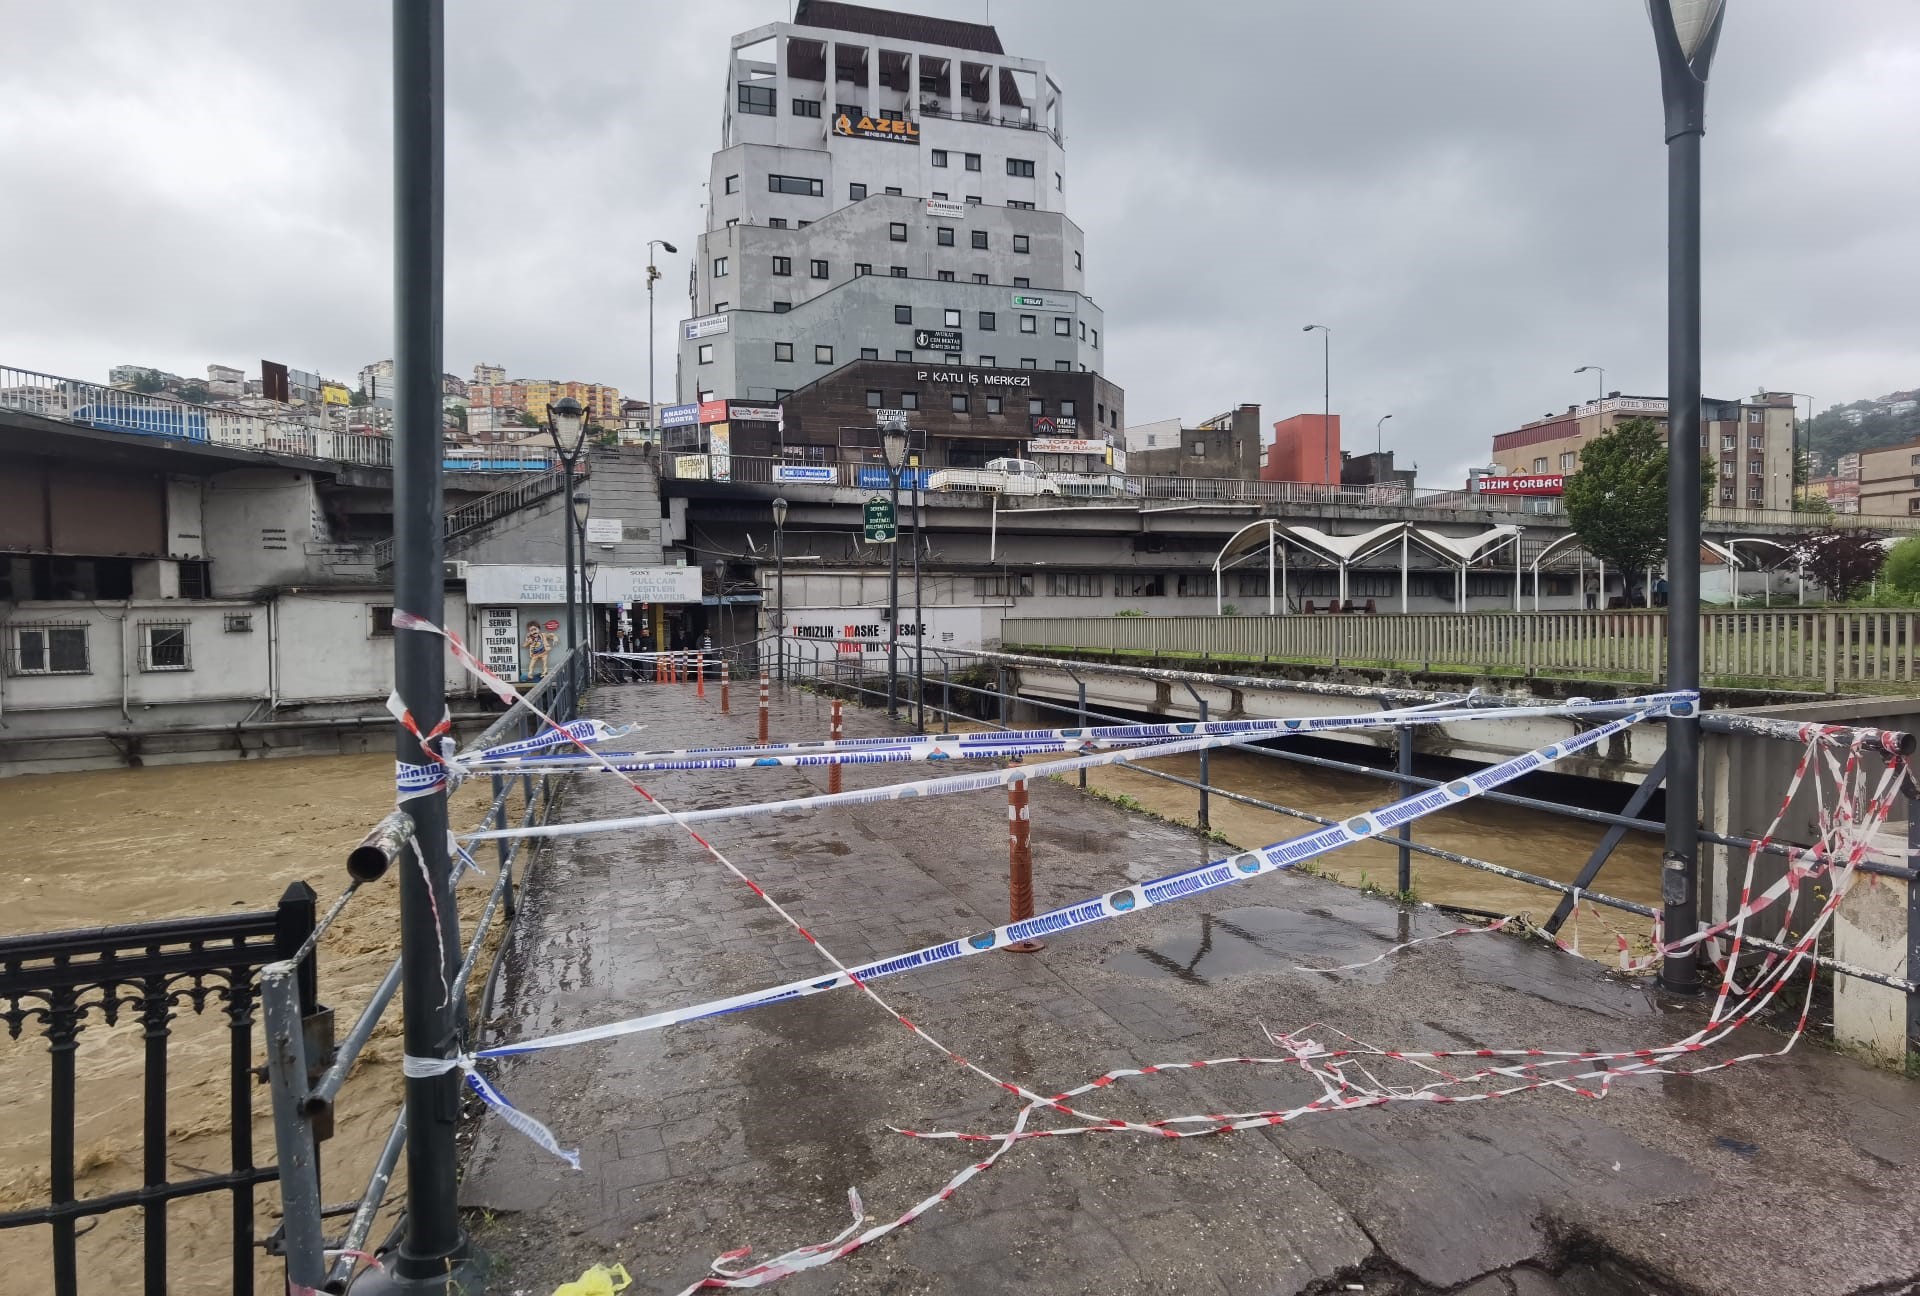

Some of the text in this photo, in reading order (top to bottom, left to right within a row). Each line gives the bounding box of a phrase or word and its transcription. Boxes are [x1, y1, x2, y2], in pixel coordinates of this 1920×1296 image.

[856, 116, 919, 135] AZEL
[917, 370, 1030, 387] 12 KATLI İŞ MERKEZİ
[1577, 406, 1594, 416] OTEL
[1620, 400, 1668, 410] OTEL BURCU
[663, 407, 698, 418] ANADOLU
[1479, 478, 1563, 492] BİZİM ÇORBACI
[632, 577, 677, 585] FULL CAM
[520, 592, 551, 600] ALINIR
[652, 593, 685, 601] YAPILIR
[844, 624, 880, 638] MASKE
[485, 636, 516, 645] TELEFONU
[488, 655, 513, 664] YAPILIR
[1513, 754, 1541, 776] ZABITA
[1375, 791, 1450, 827] ZABITA MÜDÜRLÜĞÜ
[1266, 825, 1349, 866] ZABITA MÜDÜRLÜĞÜ
[1143, 866, 1234, 904] ZABITA MÜDÜRLÜĞÜ
[1006, 902, 1105, 941] ZABITA MÜDÜRLÜĞÜ
